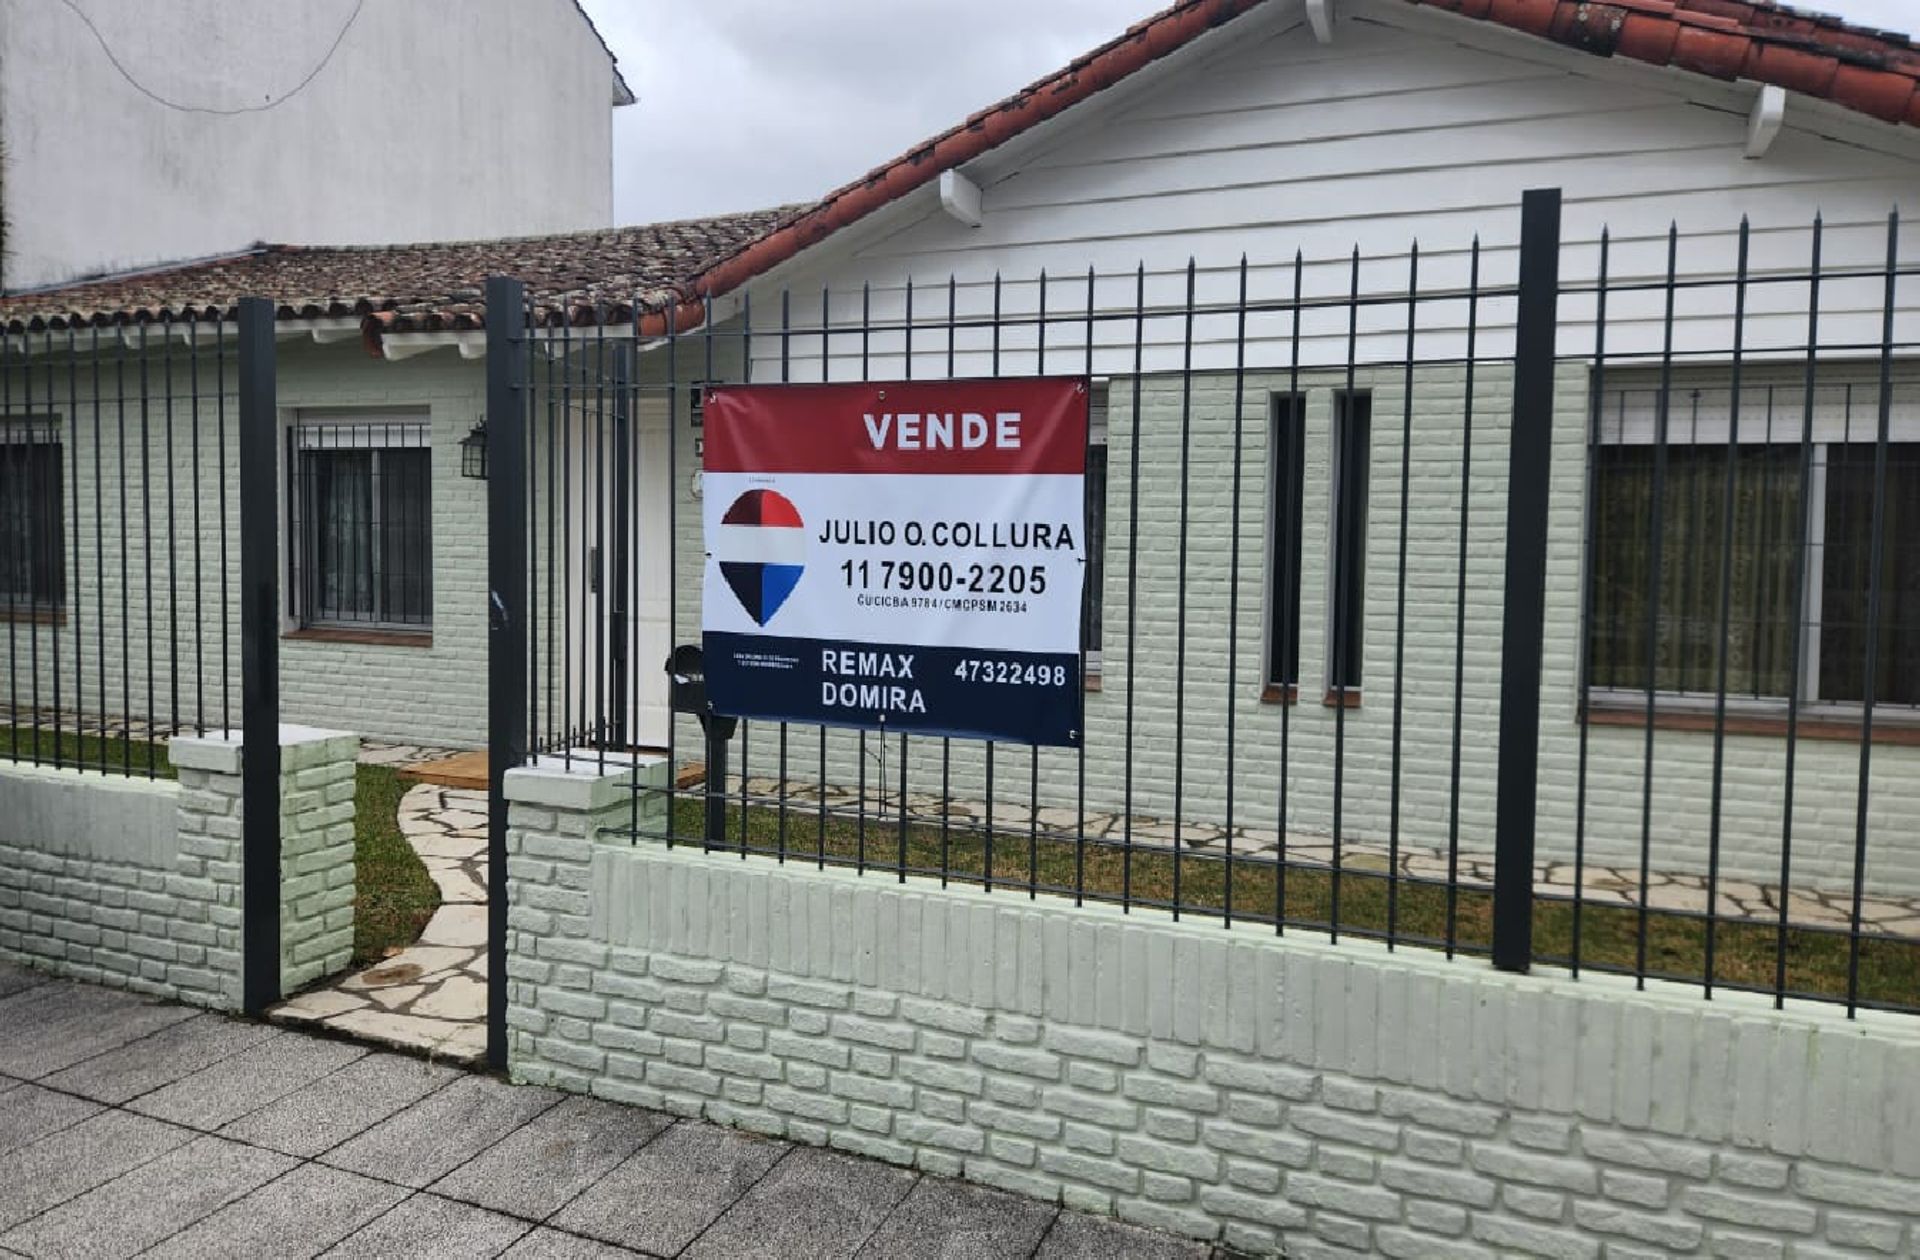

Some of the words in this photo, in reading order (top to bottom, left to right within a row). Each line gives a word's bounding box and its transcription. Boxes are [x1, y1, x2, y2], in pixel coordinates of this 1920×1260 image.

[863, 412, 1022, 450] VENDE
[818, 519, 896, 546] JULIO
[841, 559, 868, 588] 11
[881, 560, 1046, 595] 7900-2205
[857, 593, 909, 608] CUCICBA
[1000, 600, 1027, 613] 2634
[822, 650, 914, 679] REMAX
[954, 659, 1066, 686] 47322498
[822, 681, 926, 713] DOMIRA
